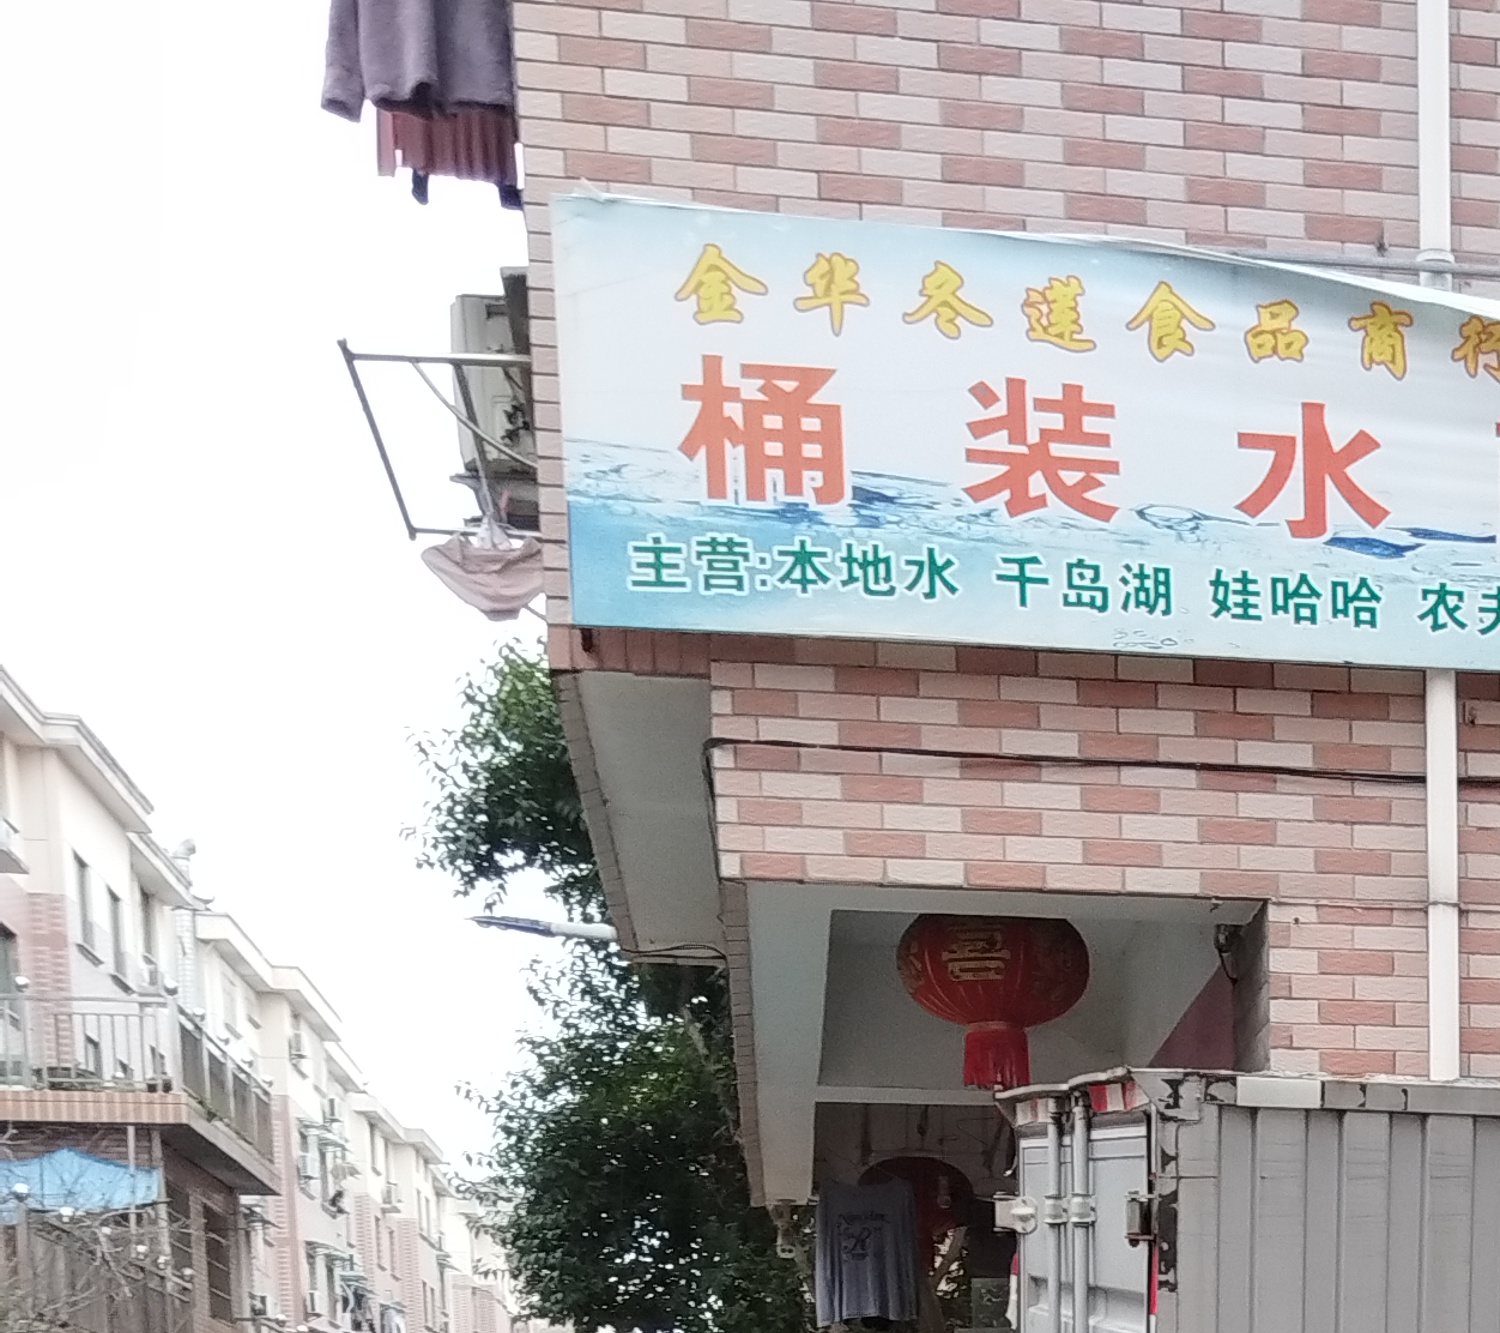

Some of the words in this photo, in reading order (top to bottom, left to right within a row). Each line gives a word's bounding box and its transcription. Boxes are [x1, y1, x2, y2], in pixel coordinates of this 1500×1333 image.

[628, 535, 960, 601] 主营:本地水
[994, 555, 1174, 617] 千岛湖
[1209, 567, 1383, 629] 娃哈哈
